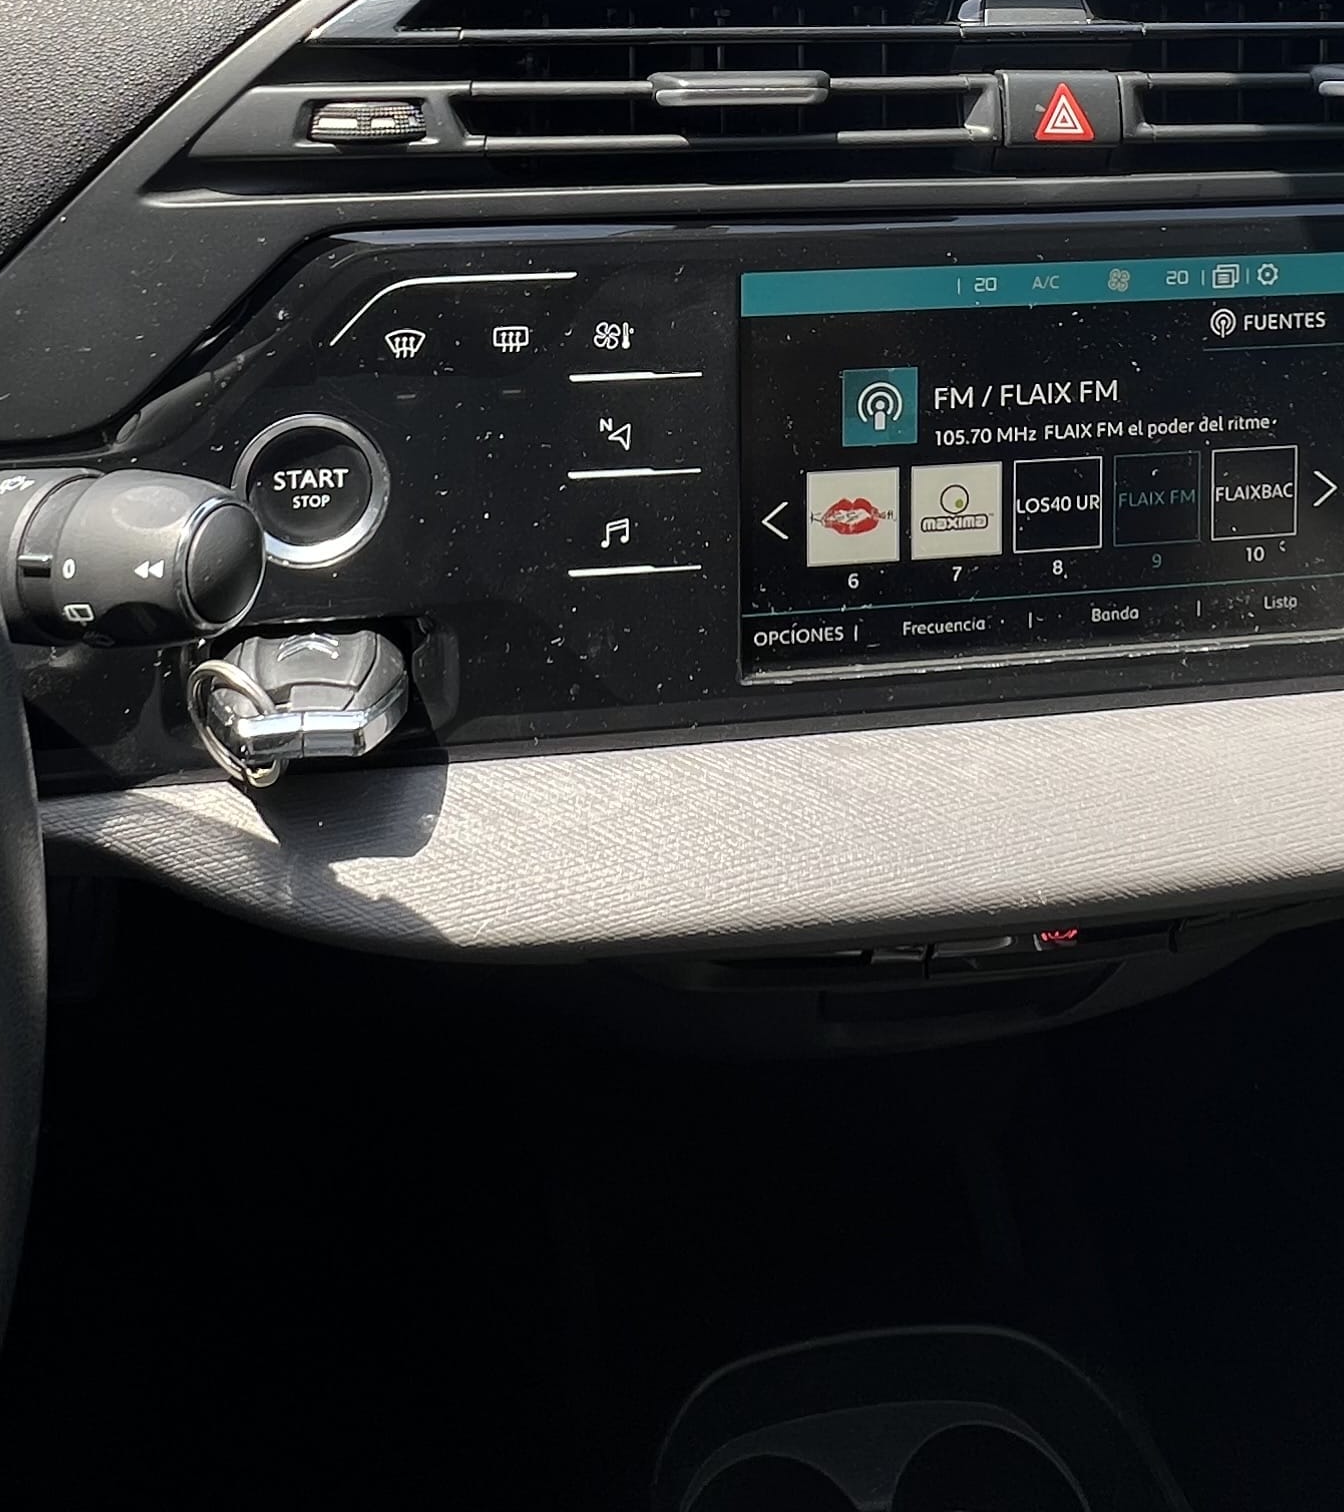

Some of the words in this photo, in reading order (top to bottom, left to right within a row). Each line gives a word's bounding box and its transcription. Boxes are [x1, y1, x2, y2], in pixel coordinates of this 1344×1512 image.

[974, 276, 997, 293] 20
[1032, 274, 1060, 290] A/C
[1165, 269, 1189, 285] 20
[1243, 311, 1326, 331] FUENTES
[934, 386, 974, 410] FM
[1000, 381, 1072, 407] FLAIX
[1079, 379, 1119, 403] FM
[935, 427, 992, 446] 105.70
[996, 426, 1037, 443] MHz
[1044, 423, 1092, 441] FLAIX
[1096, 421, 1123, 438] FM
[1128, 419, 1144, 436] el
[1147, 418, 1195, 438] poder
[1198, 414, 1224, 432] del
[273, 467, 349, 491] START
[292, 493, 331, 510] STOP
[1118, 490, 1166, 508] FLAIX
[1170, 489, 1196, 505] FM
[1215, 482, 1294, 503] FLAIXBAC
[1016, 496, 1072, 515] LOS40
[1076, 494, 1100, 511] UR
[921, 513, 989, 533] maxima
[1151, 552, 1162, 569] 9
[1245, 546, 1265, 563] 10
[951, 566, 963, 583] 7
[1052, 559, 1064, 576] 8
[847, 572, 859, 589] 6
[753, 624, 845, 648] OPCIONES
[902, 617, 987, 637] Frecuencia
[1091, 606, 1140, 624] Banda
